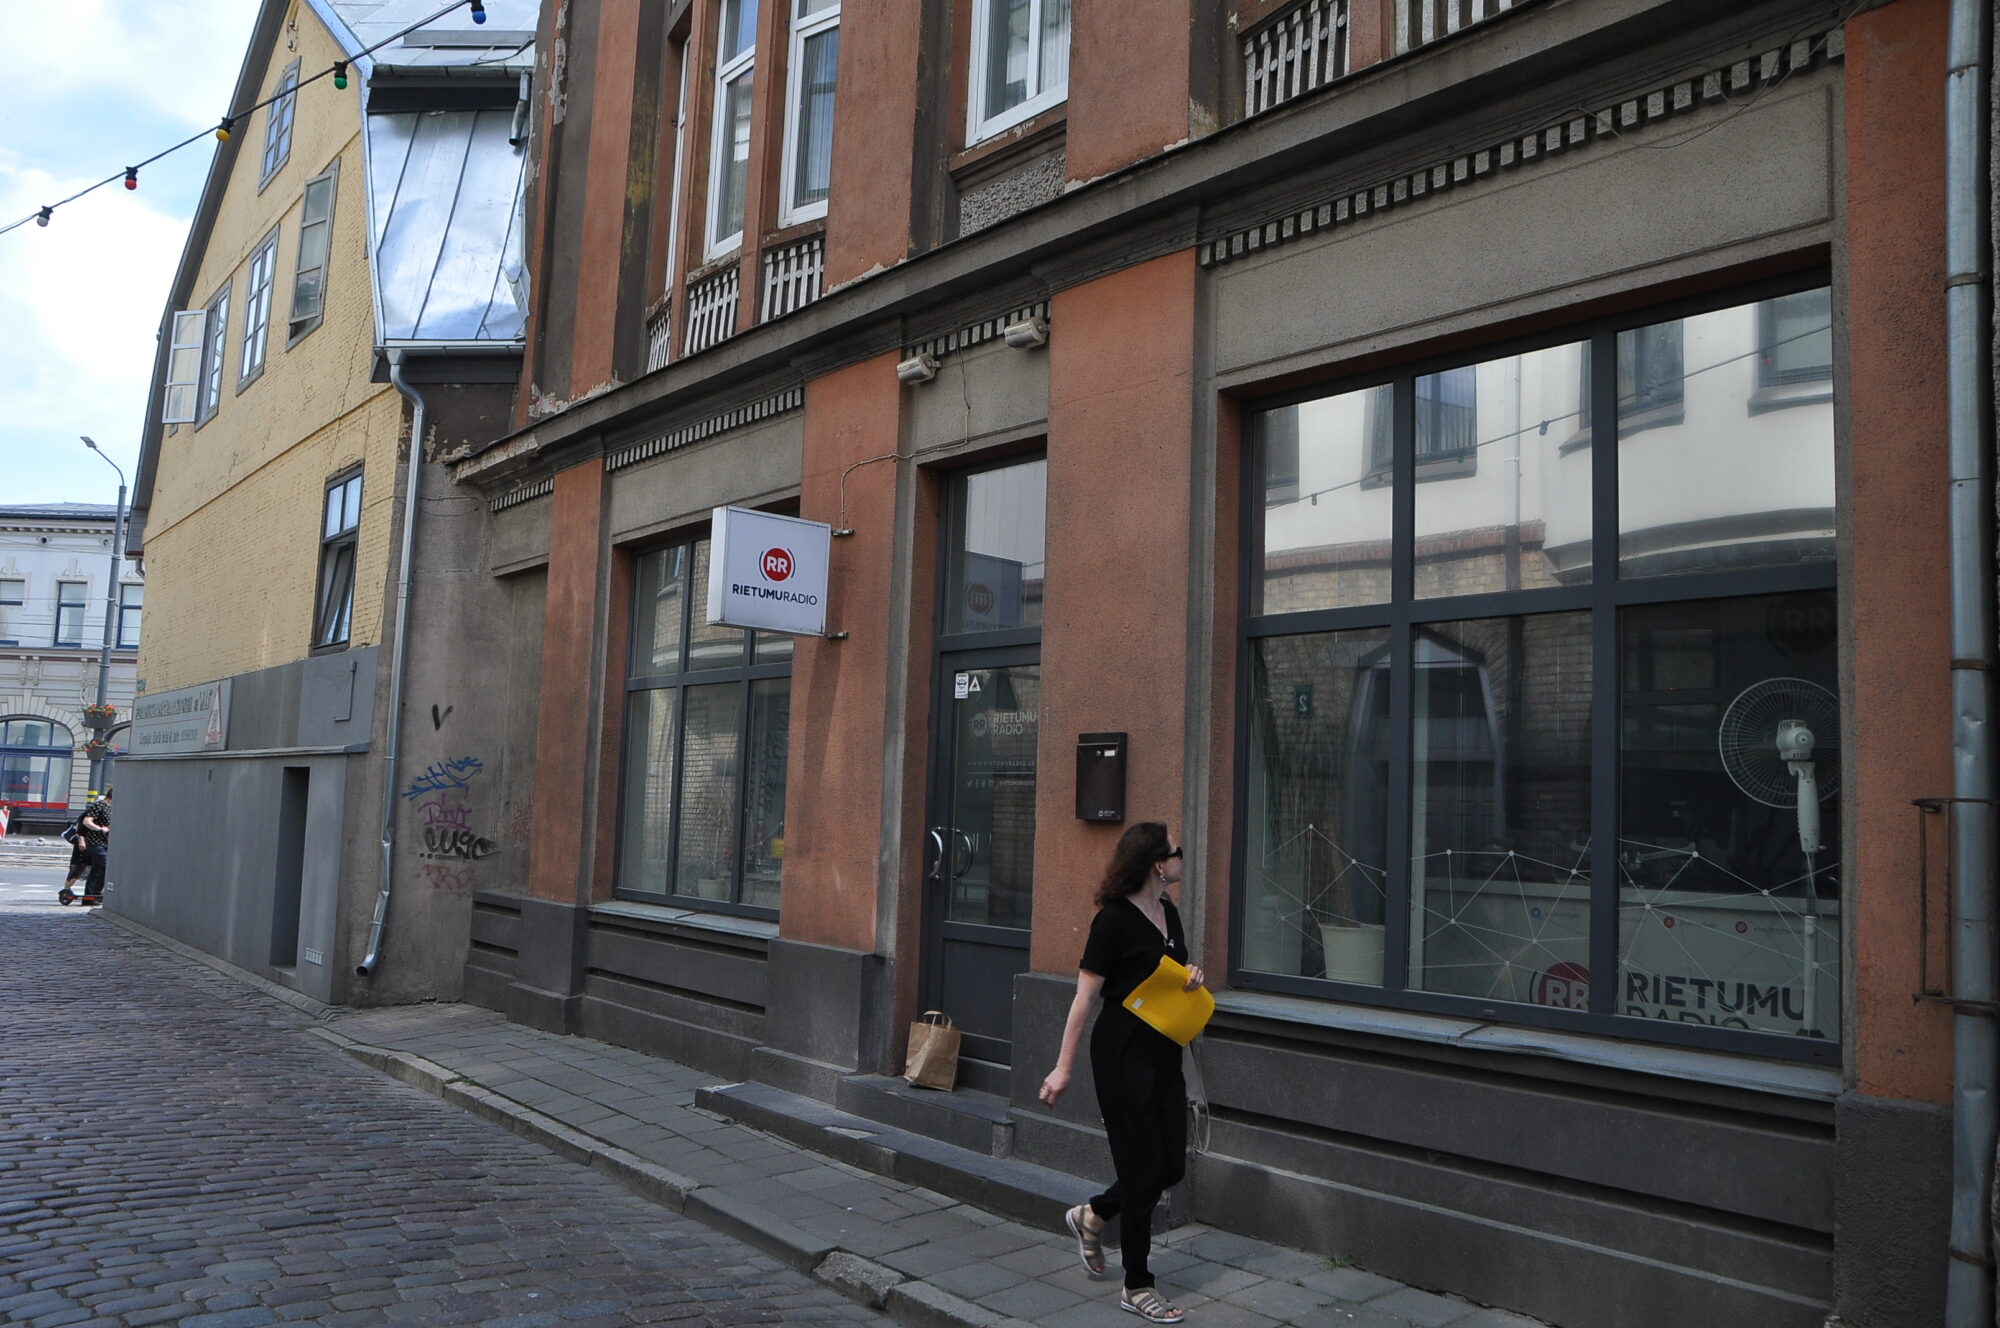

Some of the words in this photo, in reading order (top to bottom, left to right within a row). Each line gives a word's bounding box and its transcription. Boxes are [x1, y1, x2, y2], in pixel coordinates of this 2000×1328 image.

[766, 556, 788, 574] RR
[732, 583, 818, 606] RIETUMURADIO
[993, 711, 1037, 725] RIETUMU
[993, 723, 1024, 736] RADIO
[1546, 980, 1589, 1011] RR
[1627, 972, 1804, 1021] RIETUMU
